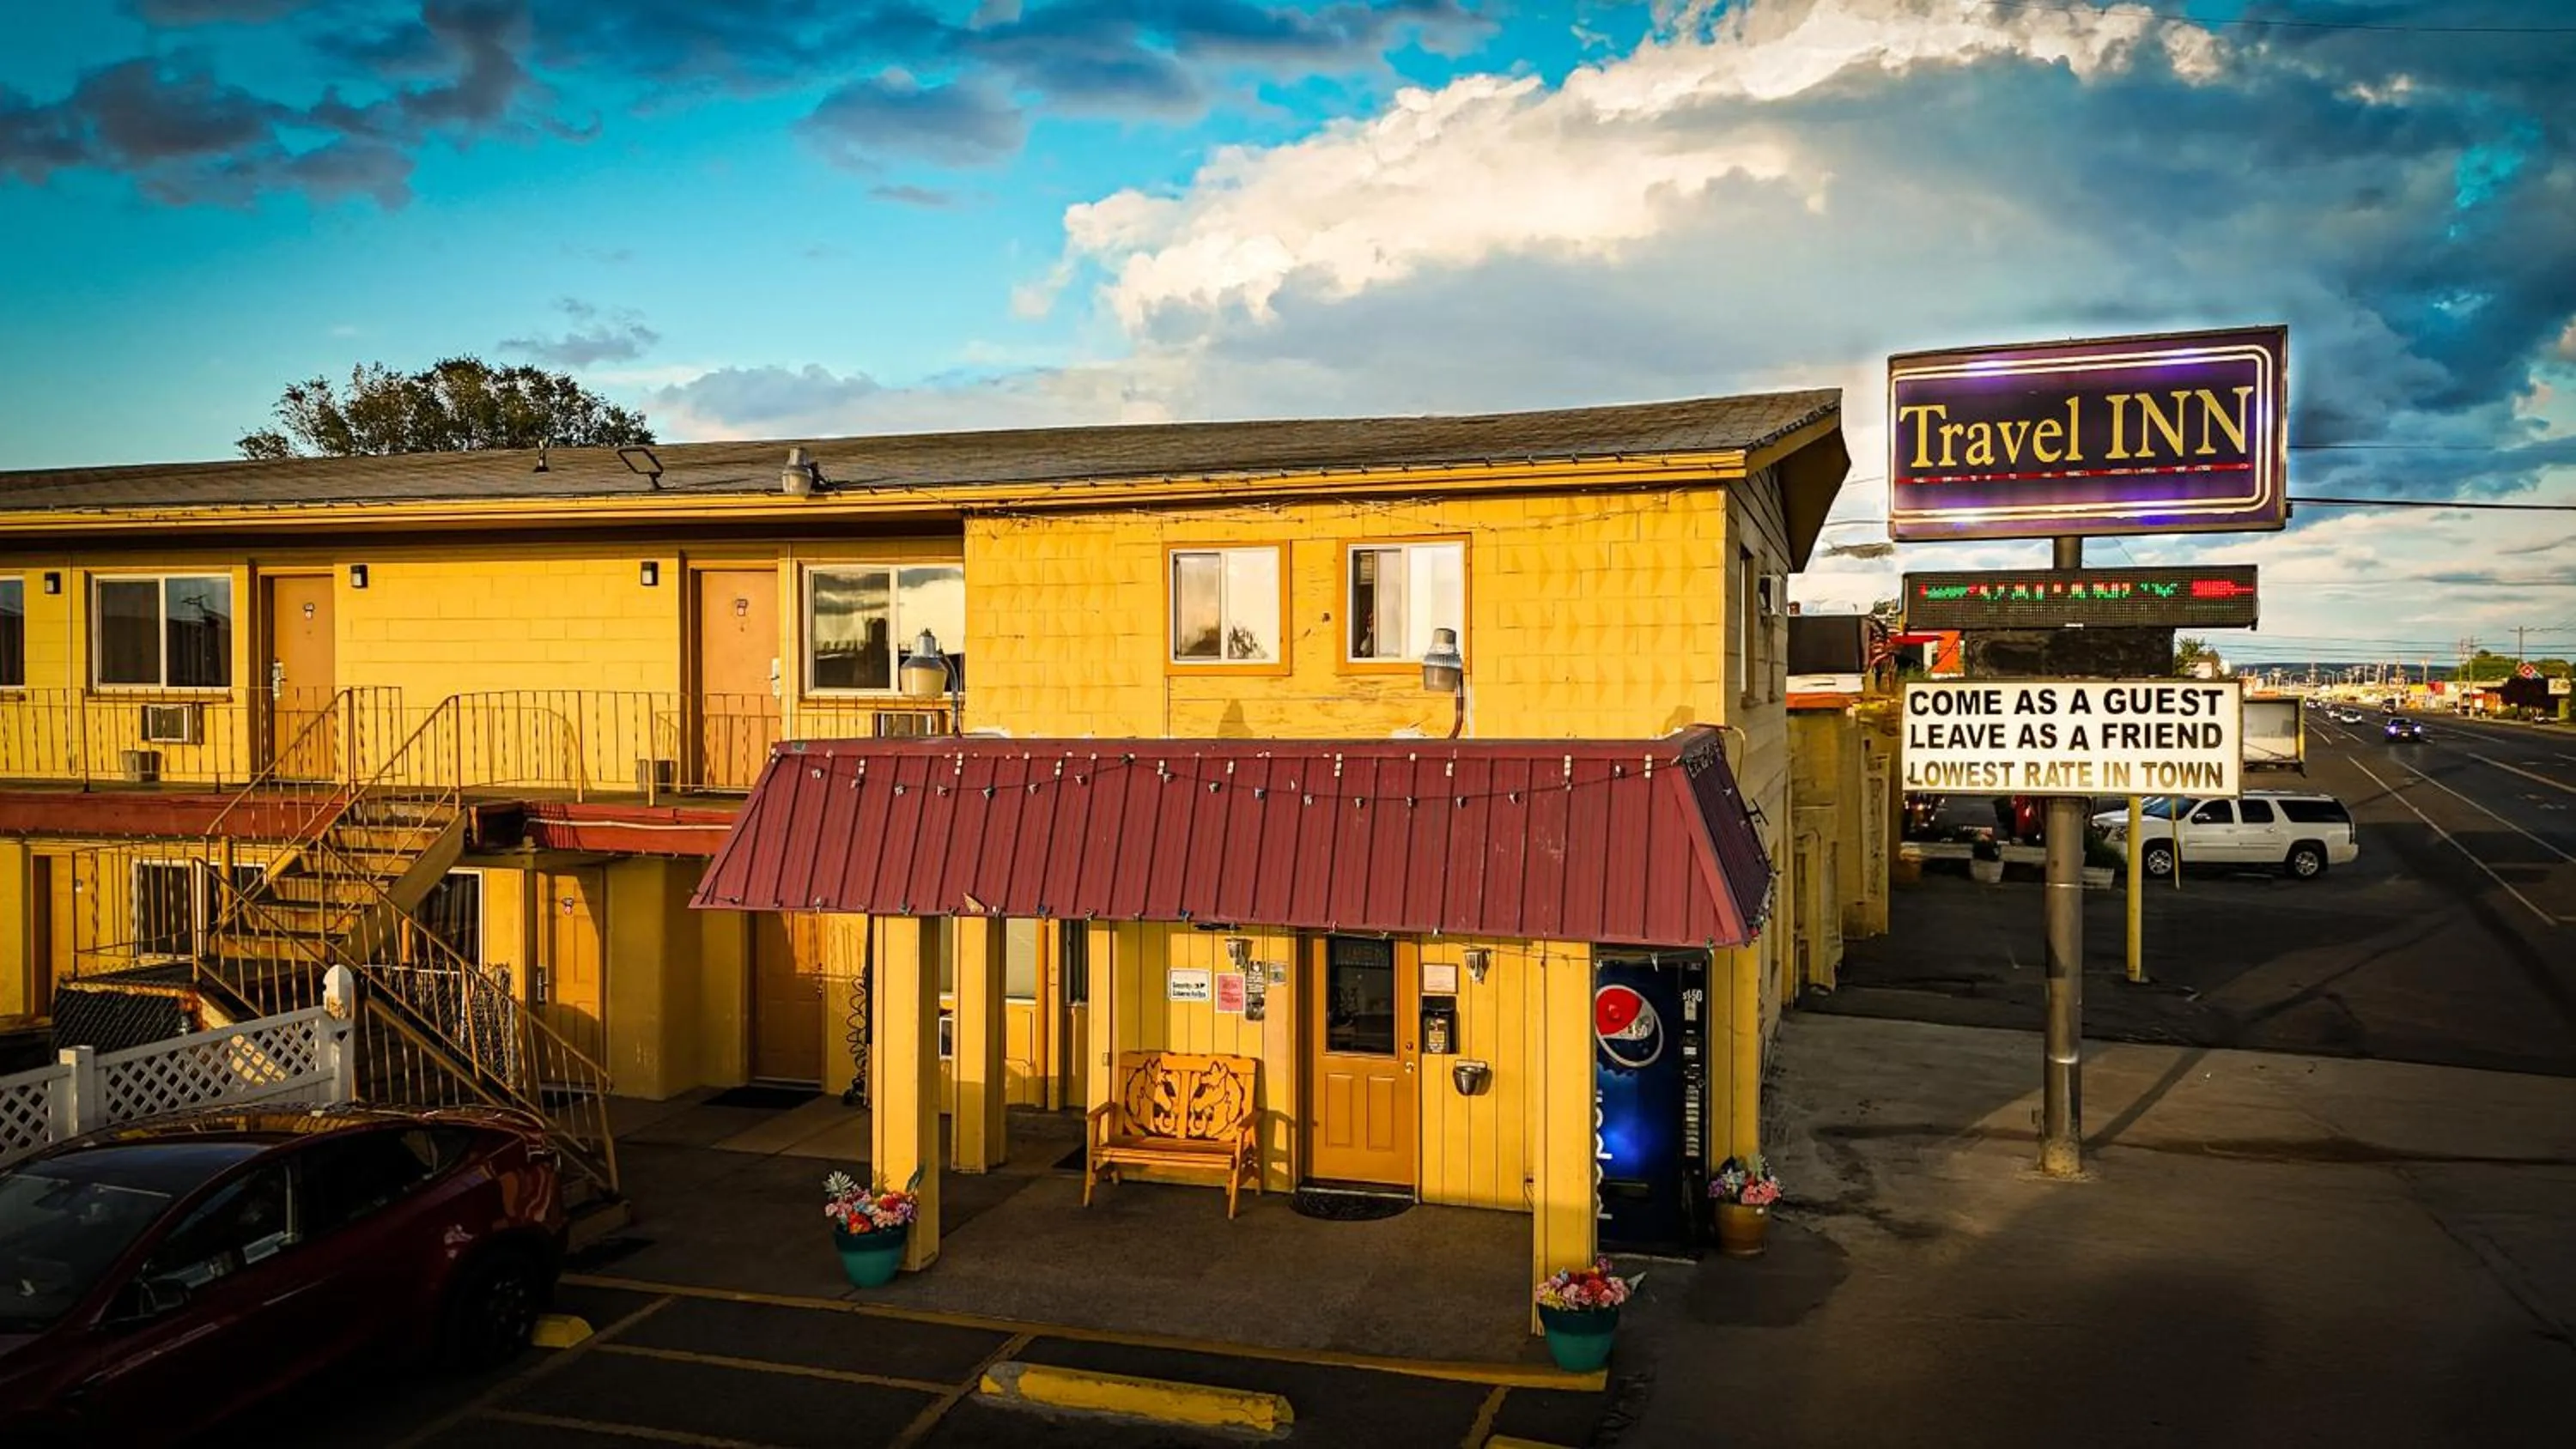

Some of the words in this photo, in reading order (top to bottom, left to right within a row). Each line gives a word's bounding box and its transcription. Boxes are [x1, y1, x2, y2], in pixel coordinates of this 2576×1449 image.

[1899, 397, 2082, 468] Travel
[2105, 386, 2254, 459] INN
[1910, 690, 2002, 716] COME
[2014, 688, 2058, 715] AS
[2069, 688, 2093, 715] A
[2104, 688, 2224, 716] GUEST
[1910, 724, 2007, 749] LEAVE
[2017, 723, 2058, 749] AS
[2069, 725, 2090, 750] A
[2102, 723, 2223, 749] FRIEND
[1906, 761, 2015, 787] LOWEST
[2026, 761, 2093, 787] RATE
[2104, 762, 2130, 787] IN
[2142, 761, 2223, 788] TOWN
